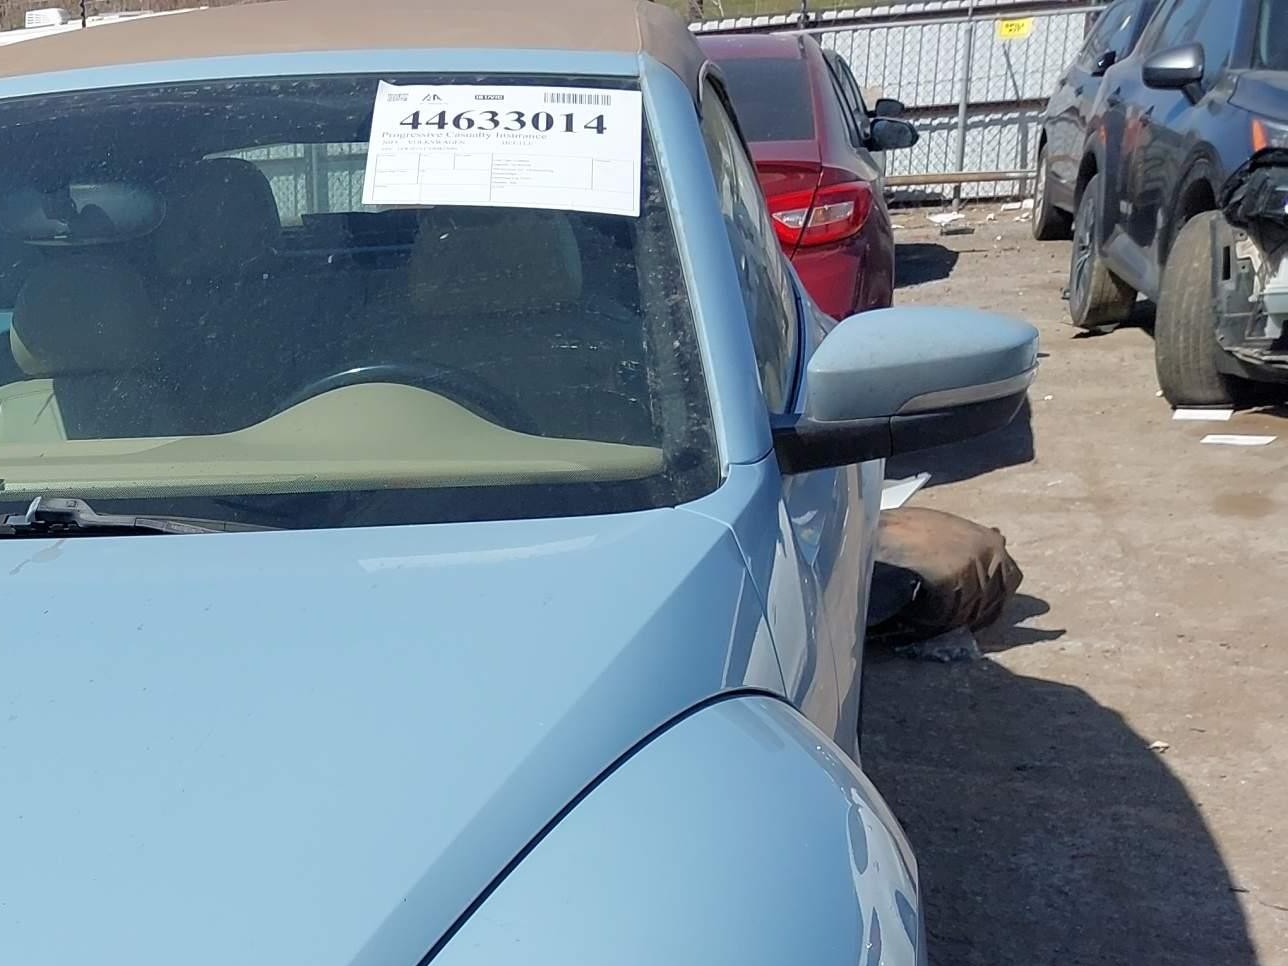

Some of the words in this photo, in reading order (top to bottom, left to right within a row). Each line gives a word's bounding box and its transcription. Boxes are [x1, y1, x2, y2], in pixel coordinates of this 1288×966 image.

[399, 109, 608, 135] 44633014
[381, 131, 444, 140] Progressive
[445, 132, 492, 140] Casualty
[495, 132, 548, 141] Insurance
